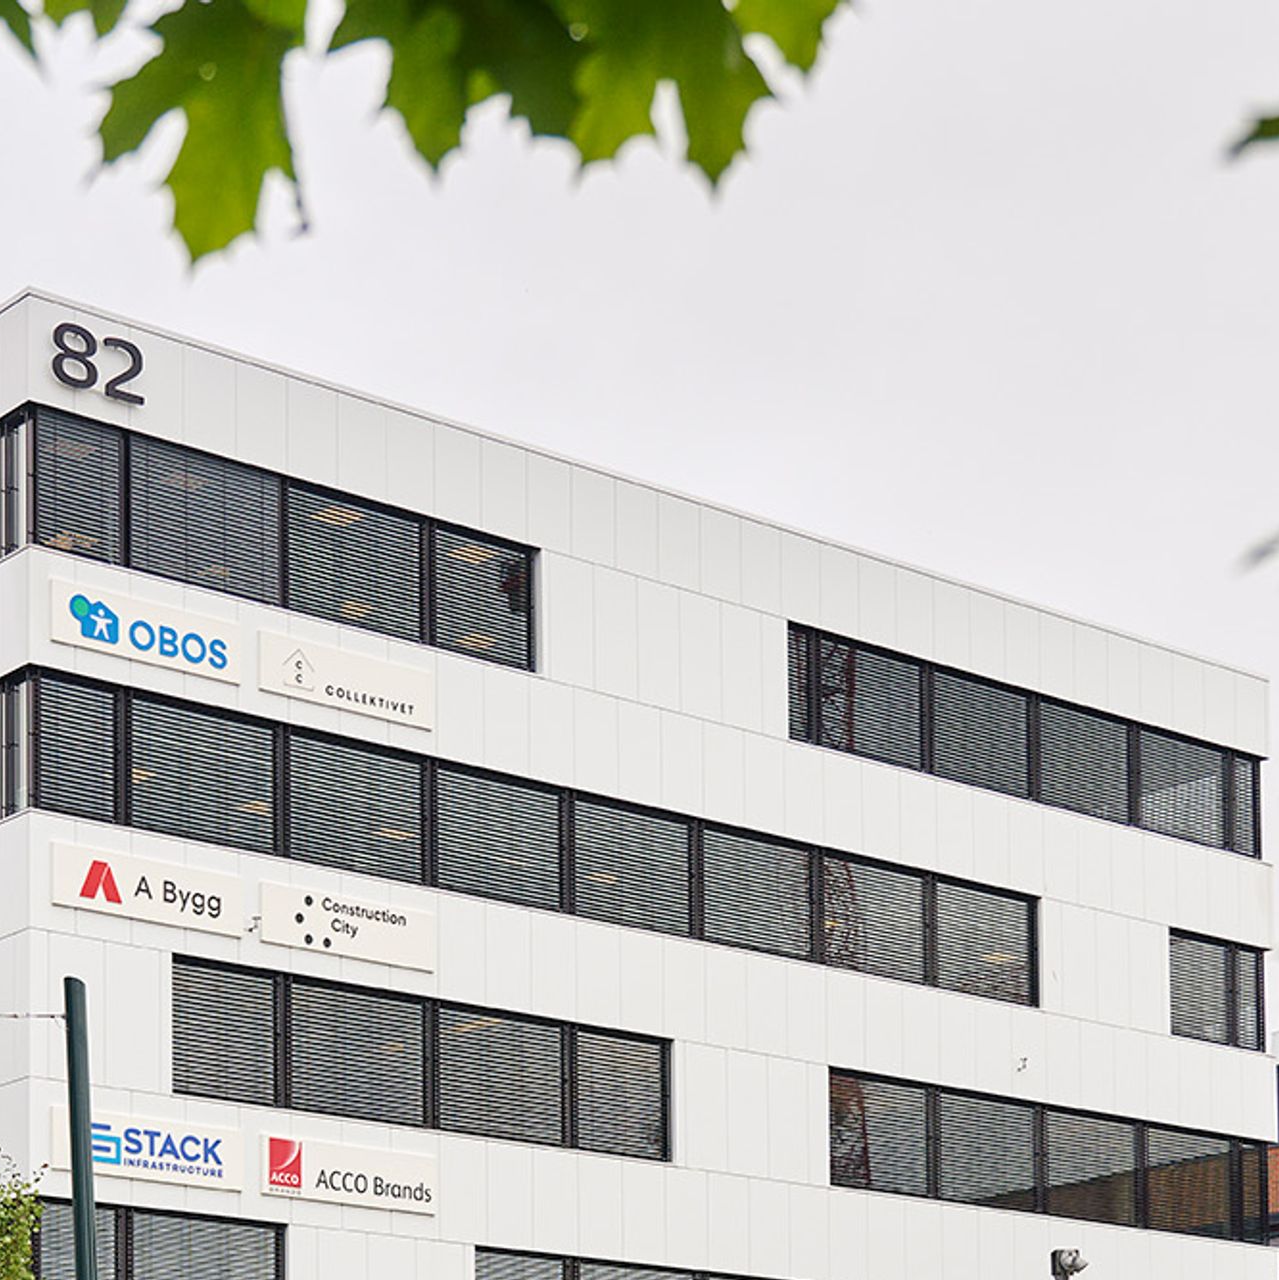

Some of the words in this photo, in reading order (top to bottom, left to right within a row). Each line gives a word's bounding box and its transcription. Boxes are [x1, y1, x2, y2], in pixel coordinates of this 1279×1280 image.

[51, 322, 145, 405] 82
[129, 620, 227, 669] OBOS
[325, 685, 414, 714] COLLEKTIVET
[134, 876, 153, 900] A
[163, 880, 221, 918] Bygg
[321, 897, 407, 926] Construction
[331, 918, 359, 938] City
[124, 1128, 222, 1166] STACK
[124, 1158, 223, 1178] INFRASTRUCTURE
[271, 1171, 299, 1185] ACCO
[315, 1169, 368, 1194] ACCO
[373, 1176, 432, 1203] Brands
